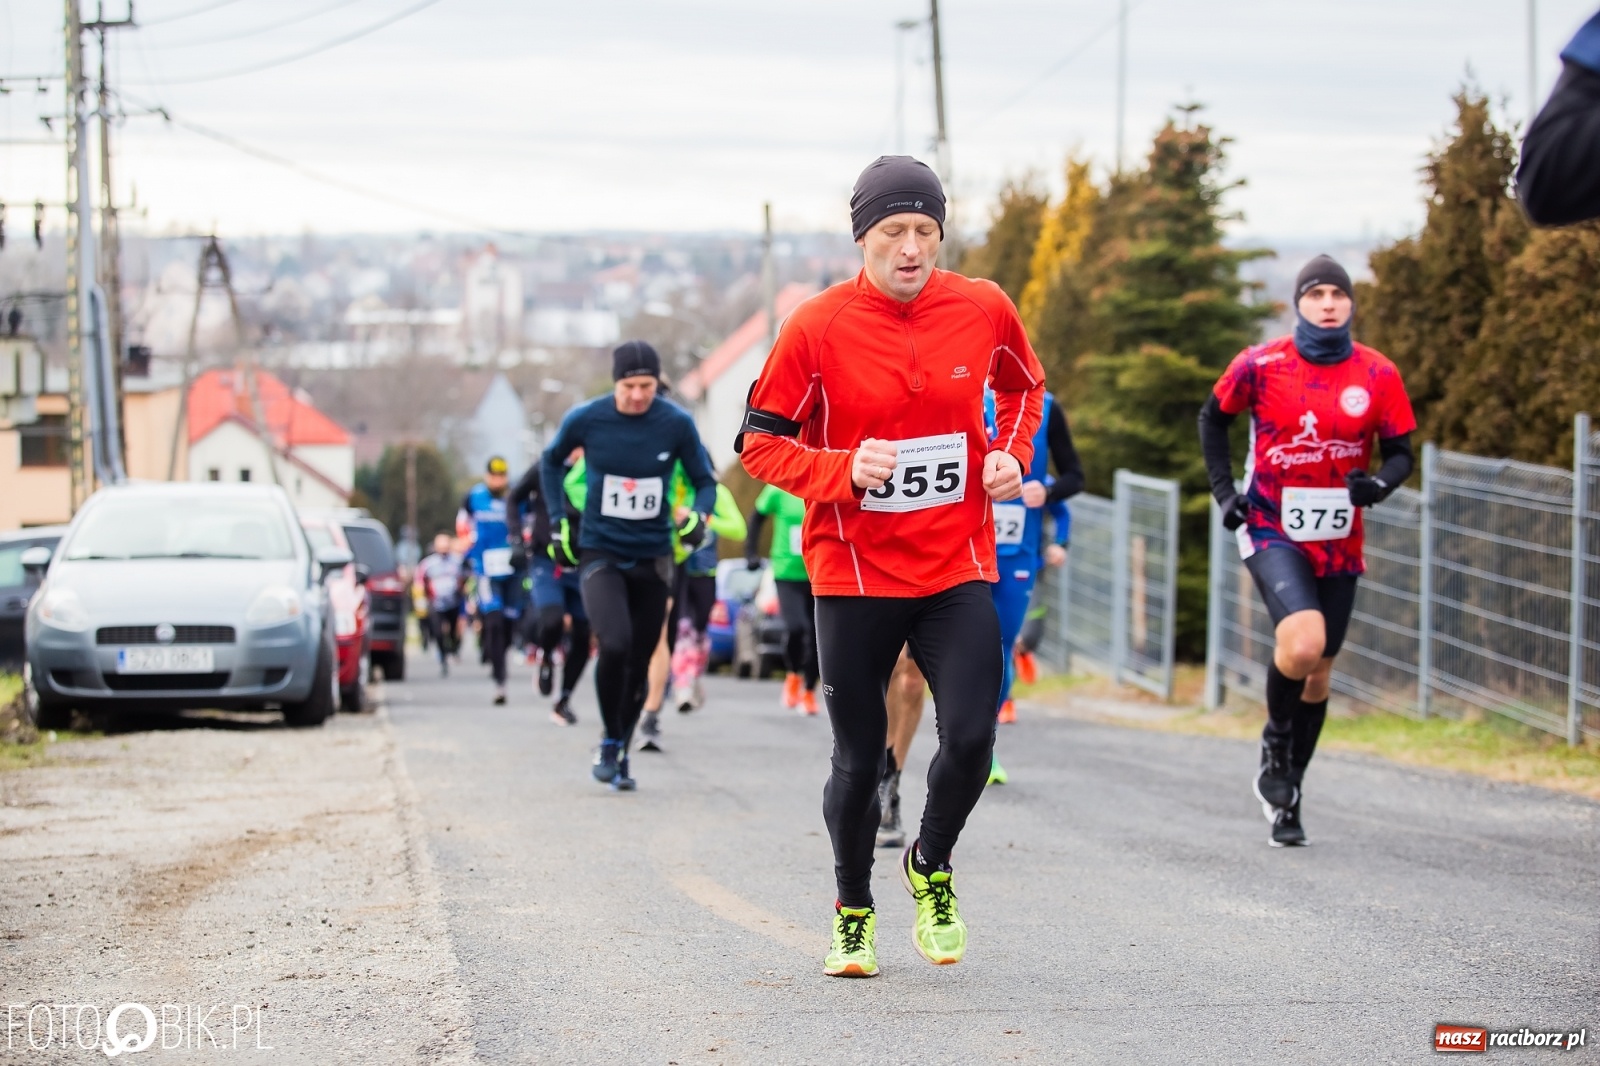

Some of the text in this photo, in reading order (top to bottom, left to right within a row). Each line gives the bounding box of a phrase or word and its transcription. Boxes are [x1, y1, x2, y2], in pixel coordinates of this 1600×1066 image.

[900, 442, 963, 454] www.personalbest.pl
[1329, 445, 1362, 460] Team
[609, 493, 656, 511] 118
[1288, 508, 1348, 530] 375
